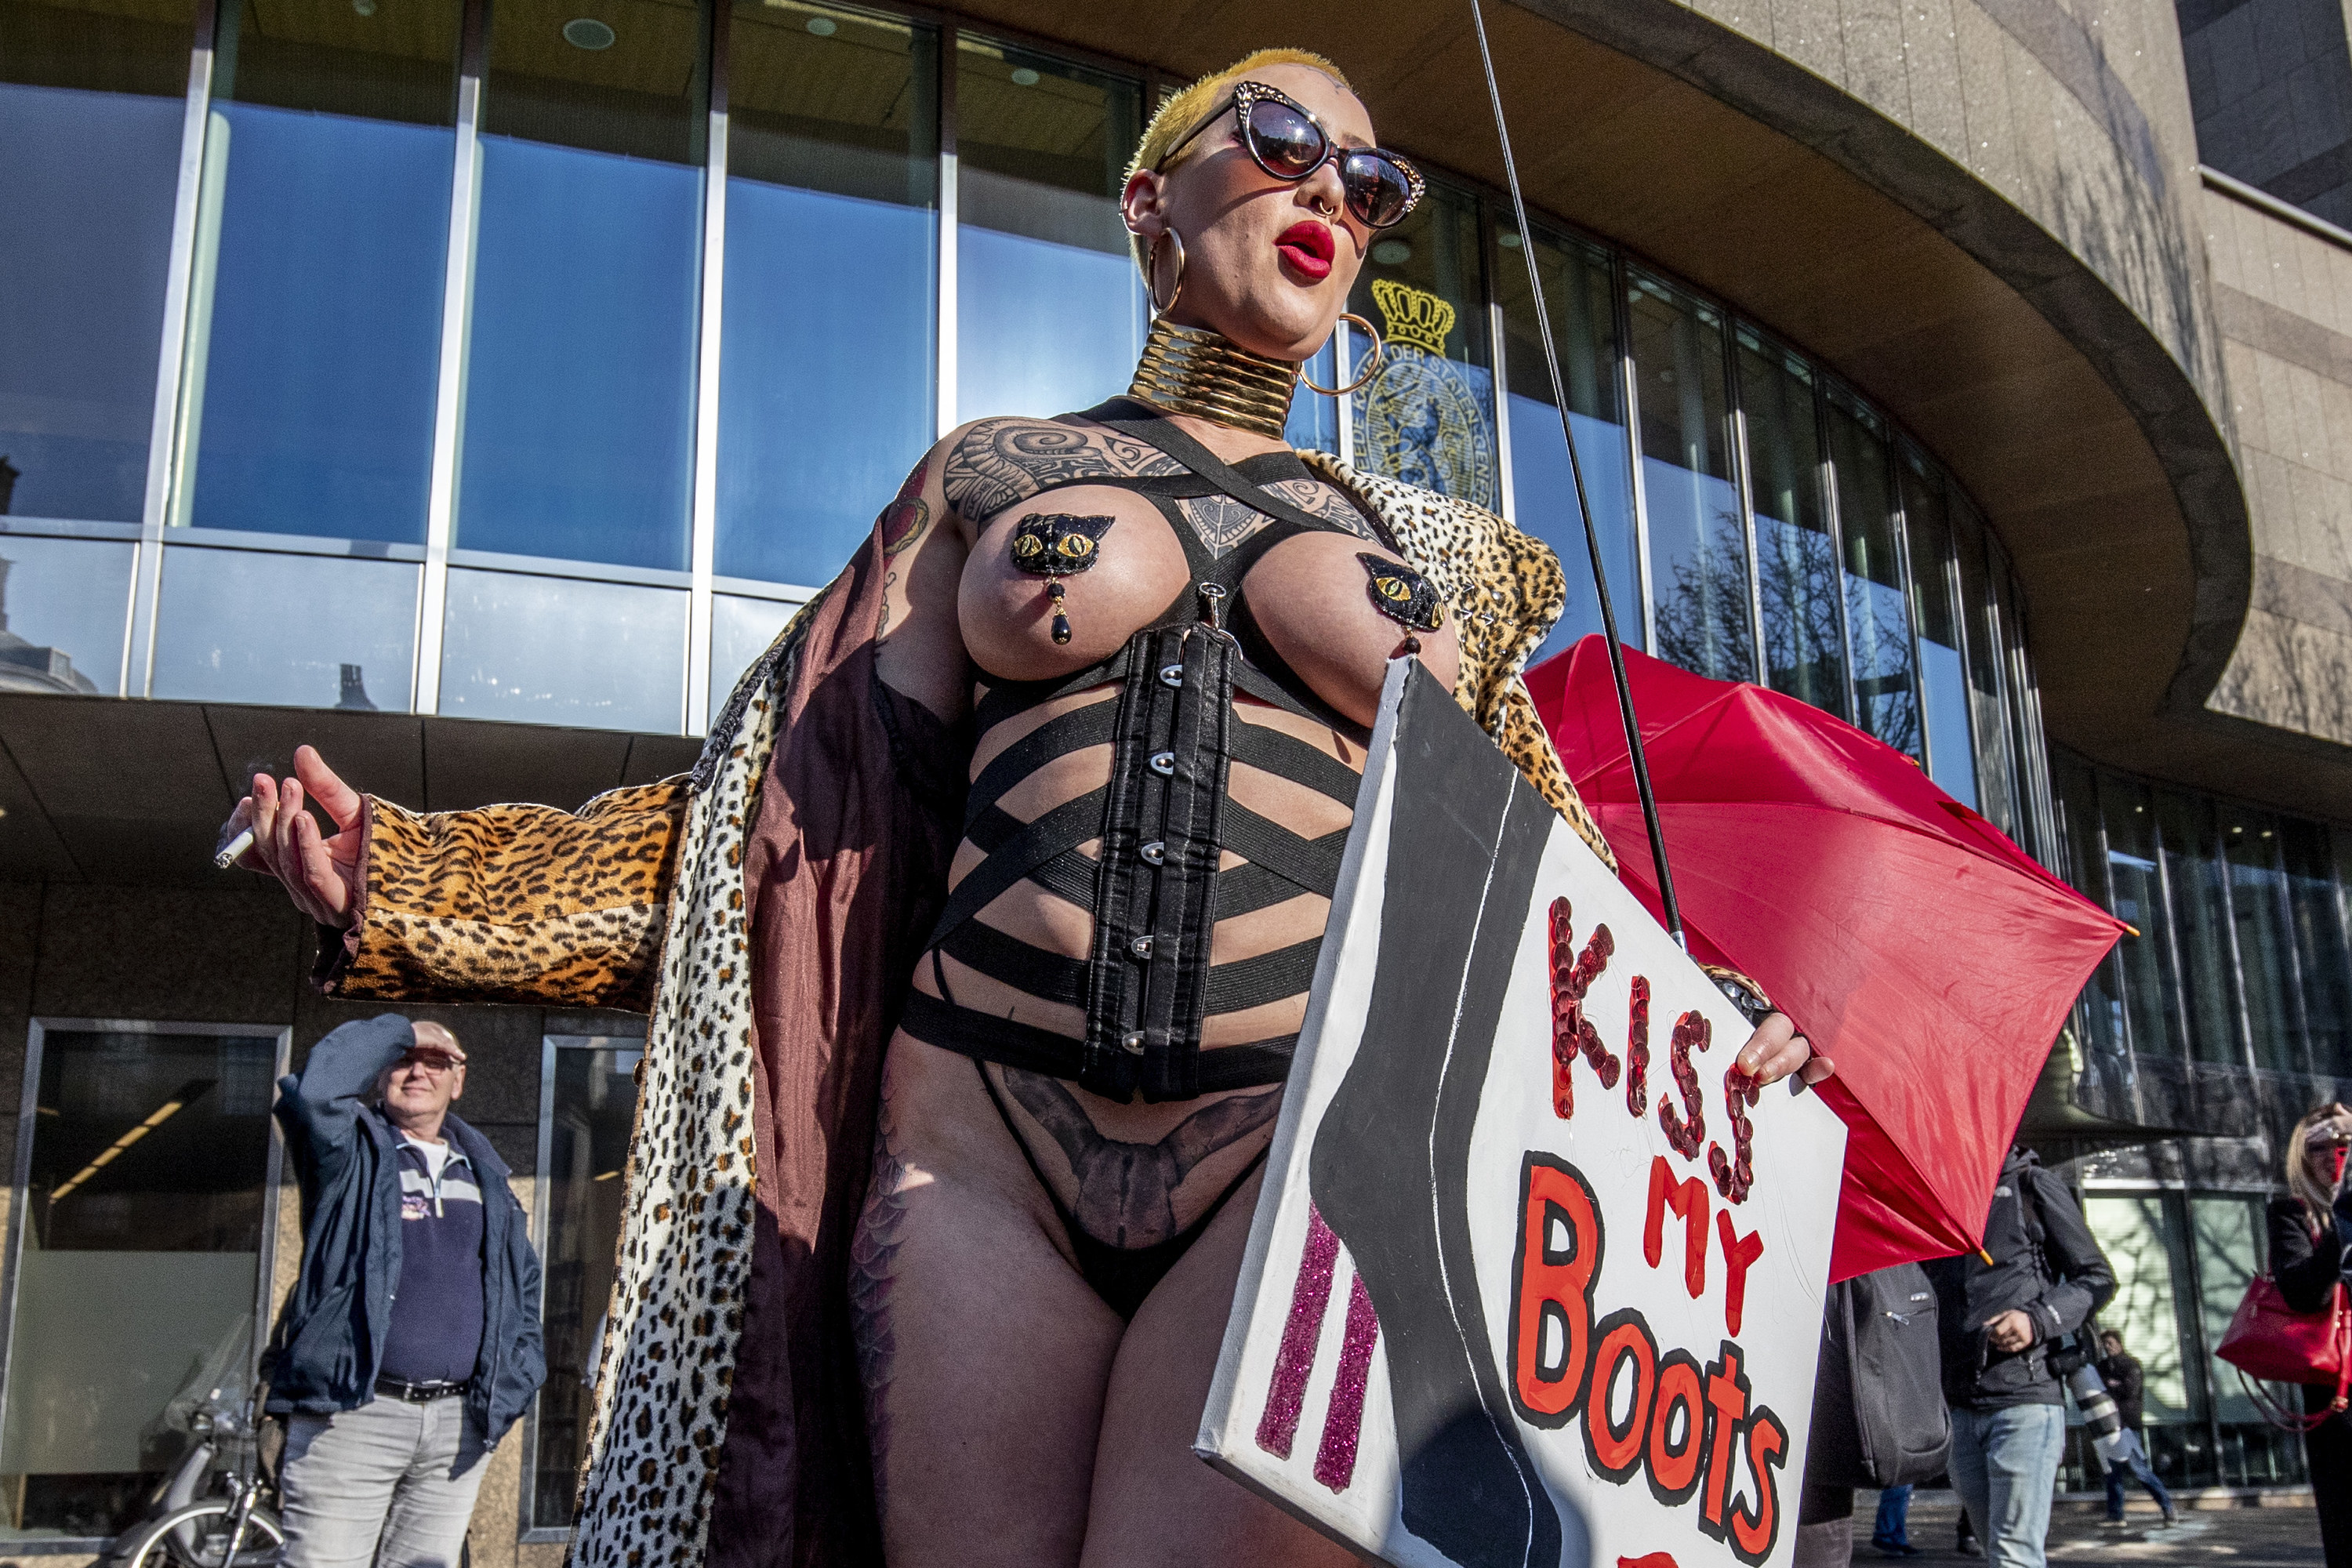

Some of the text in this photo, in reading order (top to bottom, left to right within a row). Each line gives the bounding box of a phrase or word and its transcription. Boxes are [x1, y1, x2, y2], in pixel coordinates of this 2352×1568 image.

[1389, 343, 1425, 366] DER
[1548, 896, 1761, 1205] KISS
[1643, 1155, 1764, 1338] MY
